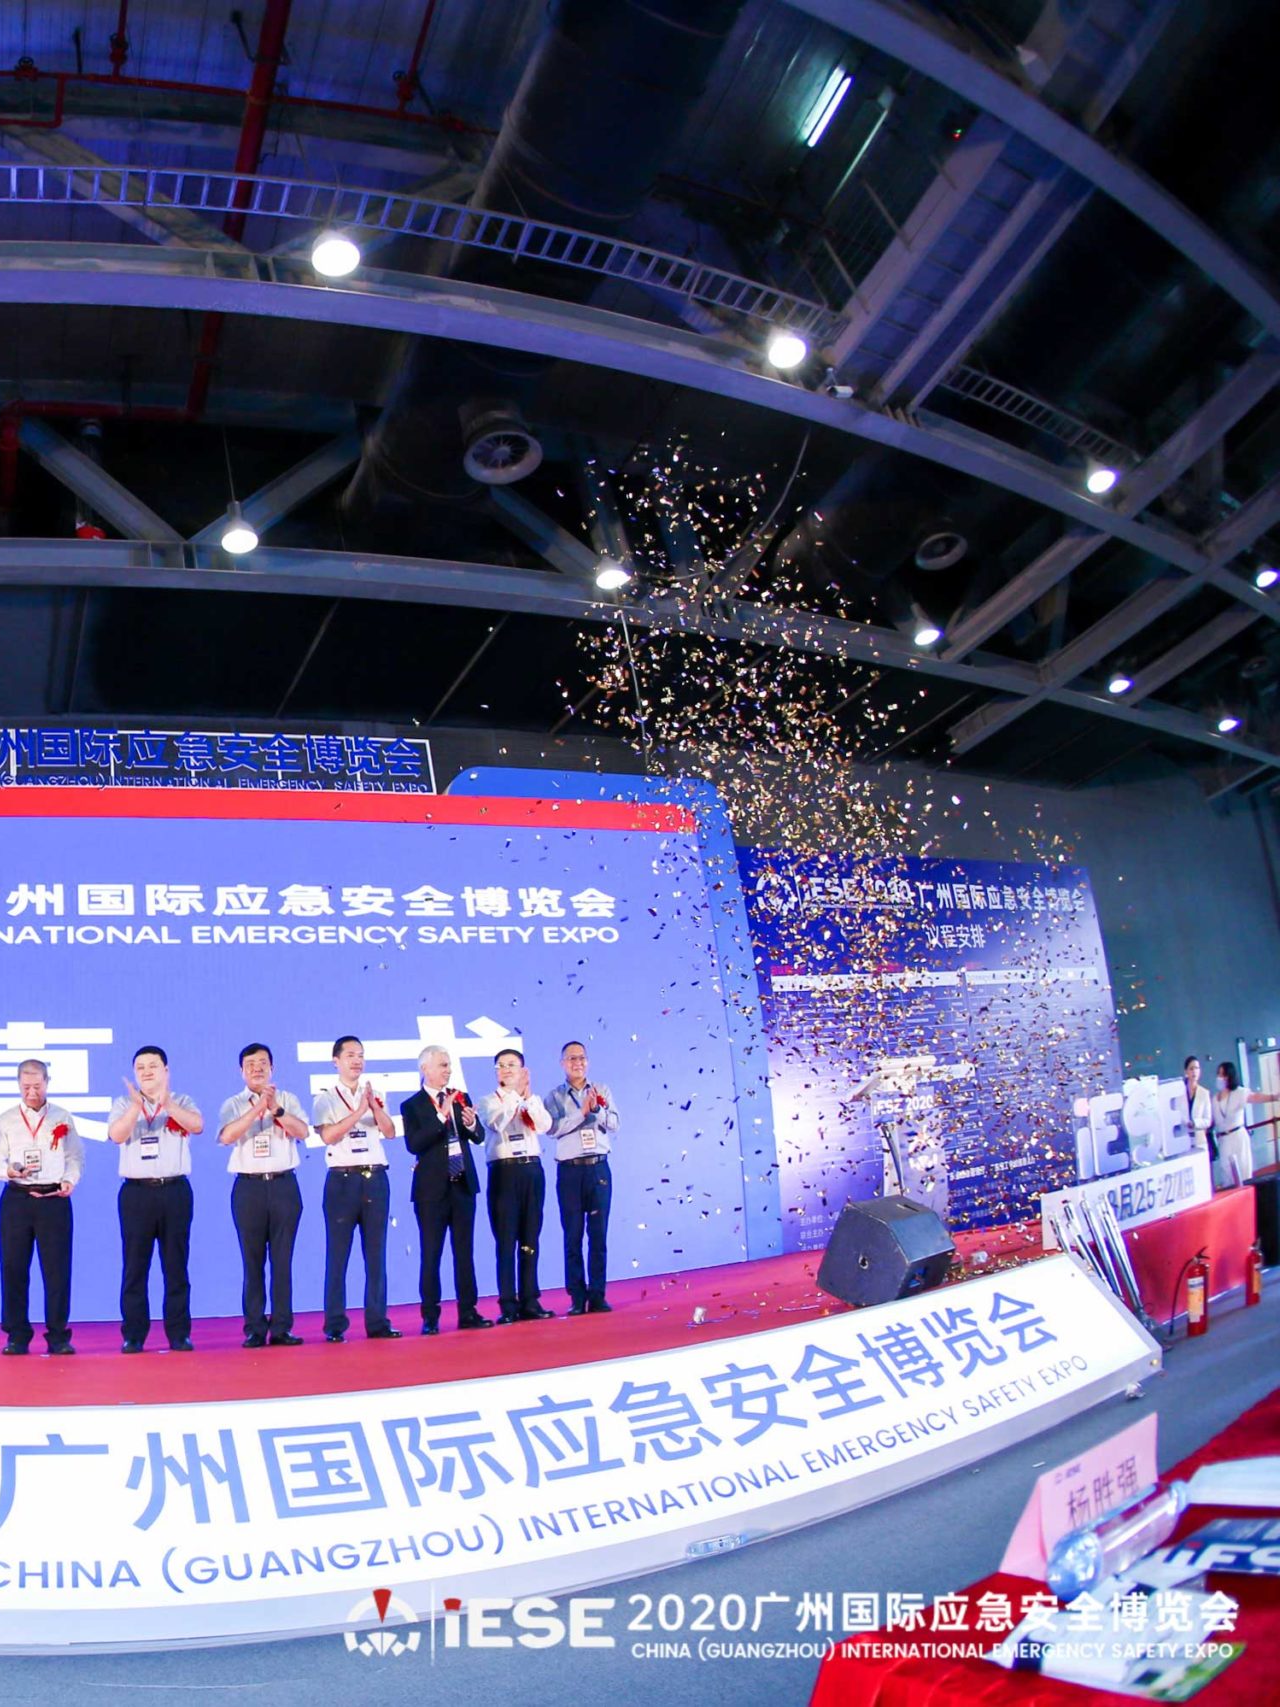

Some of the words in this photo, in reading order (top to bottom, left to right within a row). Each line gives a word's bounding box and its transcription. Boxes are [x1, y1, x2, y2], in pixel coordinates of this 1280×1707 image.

[238, 778, 325, 791] EMERGENCY
[333, 780, 386, 792] SAFETY
[392, 782, 428, 793] EXPO
[191, 925, 409, 944] EMERGENCY
[417, 926, 534, 944] SAFETY
[542, 926, 620, 944] EXPO
[161, 1514, 505, 1594] (GUANGZHOU)
[518, 1458, 801, 1542] INTERNATIONAL
[807, 1405, 958, 1474] EMERGENCY
[961, 1376, 1039, 1418] SAFETY
[1043, 1354, 1090, 1388] EXPO
